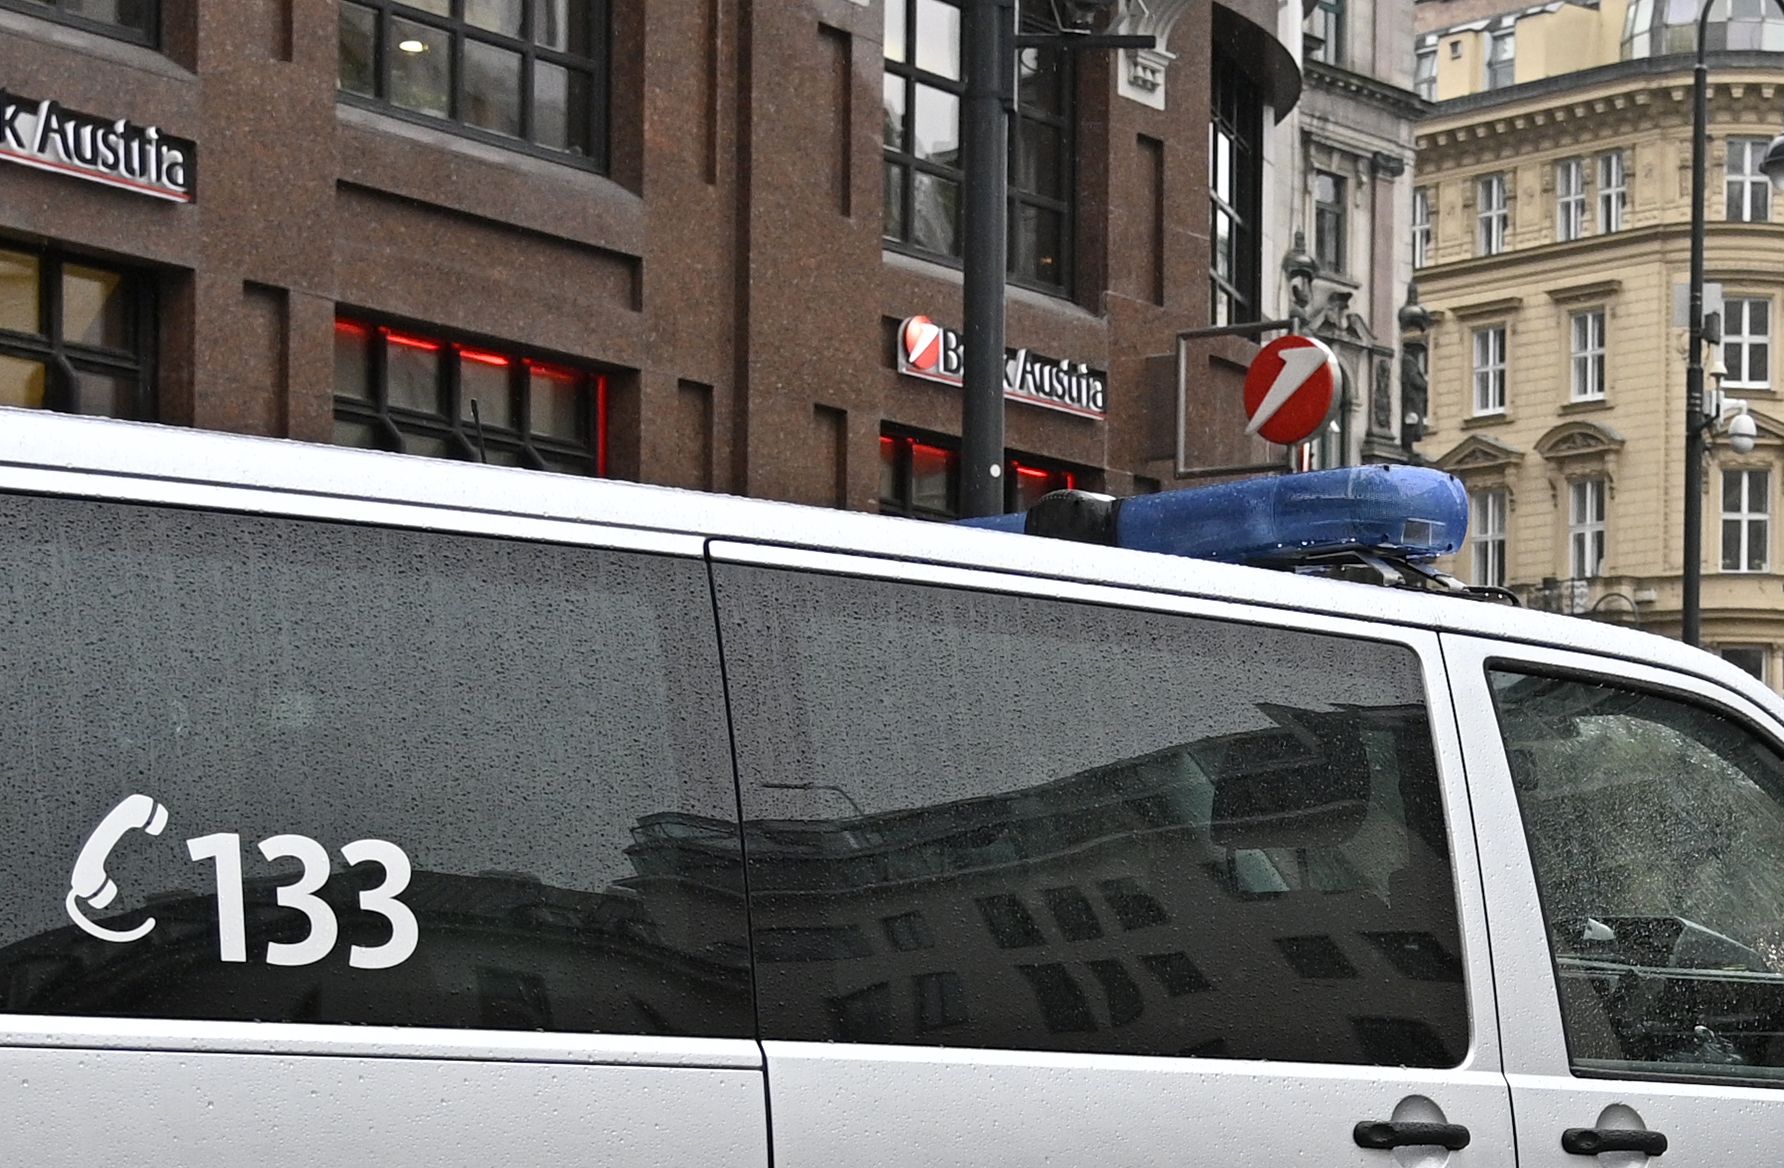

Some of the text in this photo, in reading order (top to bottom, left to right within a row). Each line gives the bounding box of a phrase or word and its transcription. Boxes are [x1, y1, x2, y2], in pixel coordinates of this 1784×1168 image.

[33, 99, 188, 192] Austria
[1013, 348, 1105, 410] Austria
[187, 832, 419, 969] 133
